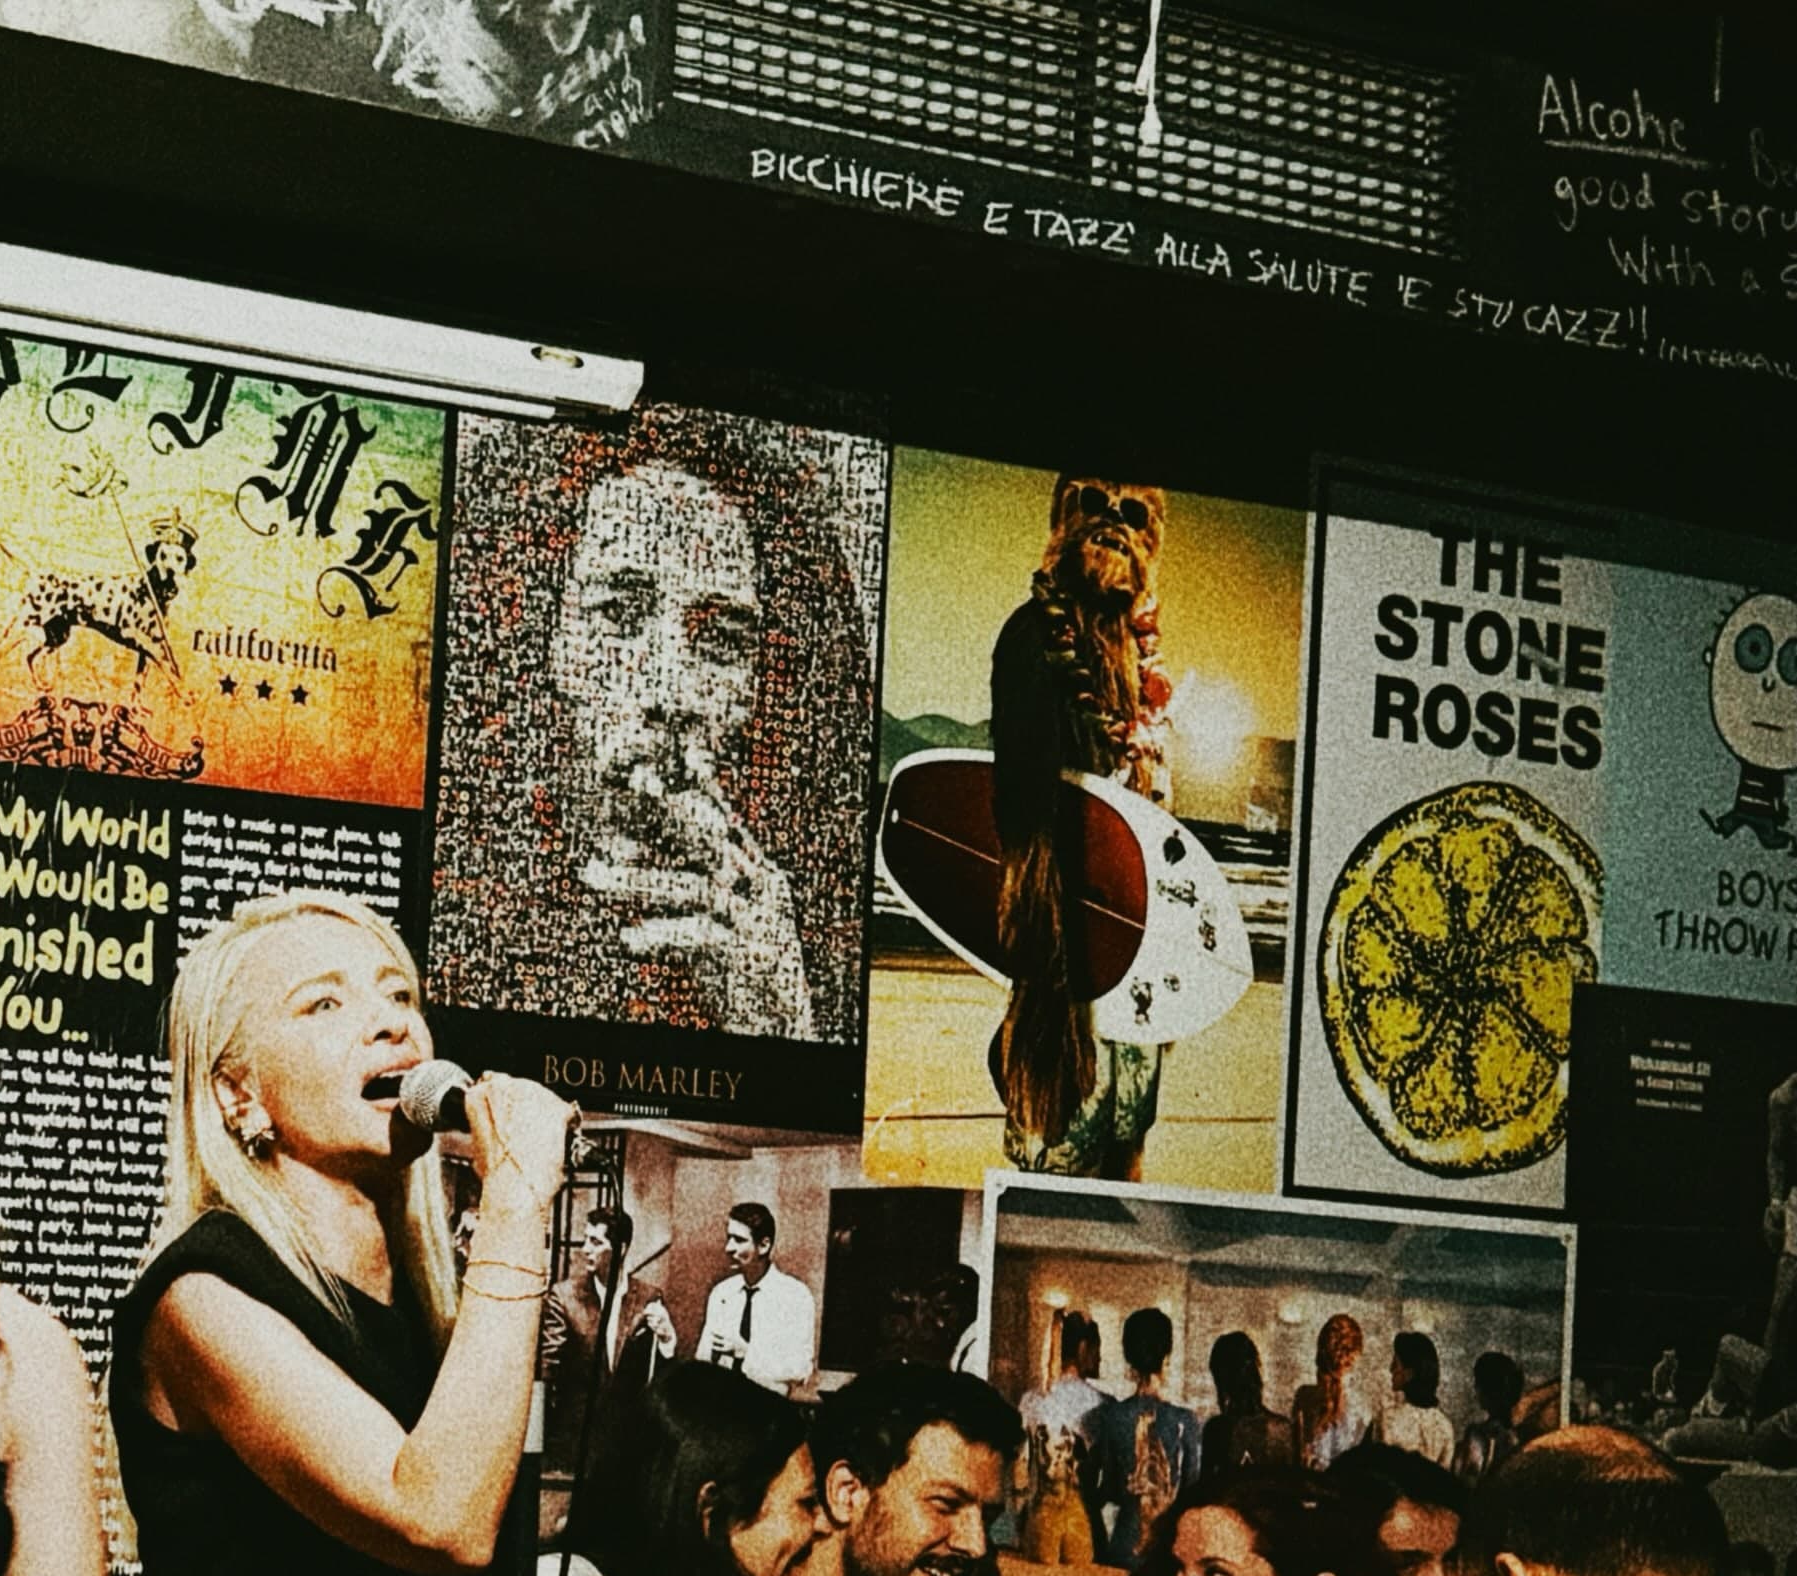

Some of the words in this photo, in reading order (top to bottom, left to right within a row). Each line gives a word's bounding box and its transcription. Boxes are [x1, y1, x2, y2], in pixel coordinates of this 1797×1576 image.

[750, 148, 965, 216] BICCHIERE
[983, 202, 1014, 236] E
[1156, 232, 1232, 280] ALLA
[1247, 248, 1374, 307] SALUTE
[1554, 171, 1655, 232] good
[1430, 528, 1564, 604] THE
[191, 622, 338, 674] california
[1373, 594, 1605, 693] STONE
[1372, 674, 1603, 771] ROSES
[61, 800, 172, 860] World
[124, 866, 170, 914] Be
[1655, 909, 1780, 961] THROW
[544, 1054, 606, 1088] BOB
[618, 1062, 743, 1100] MARLEY
